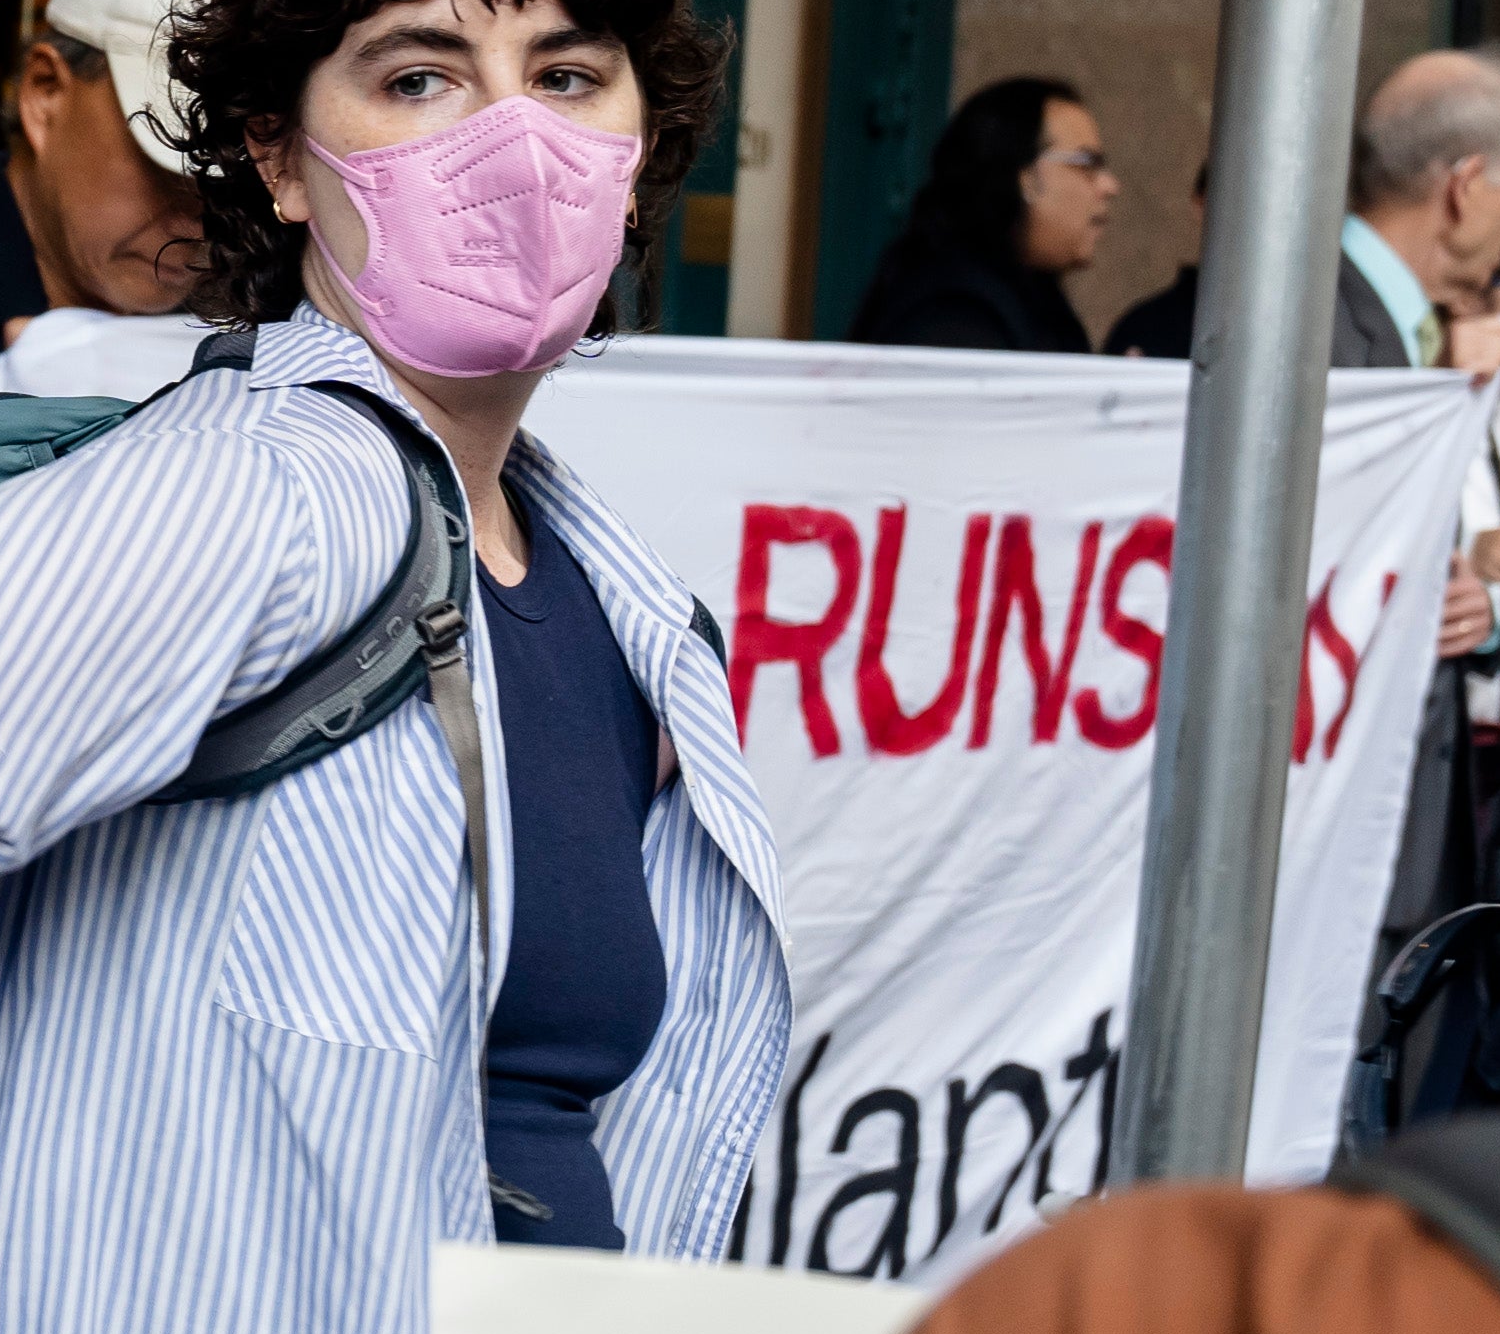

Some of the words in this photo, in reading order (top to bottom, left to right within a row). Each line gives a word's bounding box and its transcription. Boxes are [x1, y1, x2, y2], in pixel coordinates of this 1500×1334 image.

[726, 499, 1177, 758] RUNS
[1290, 567, 1398, 766] Y
[730, 1006, 1122, 1279] lant
